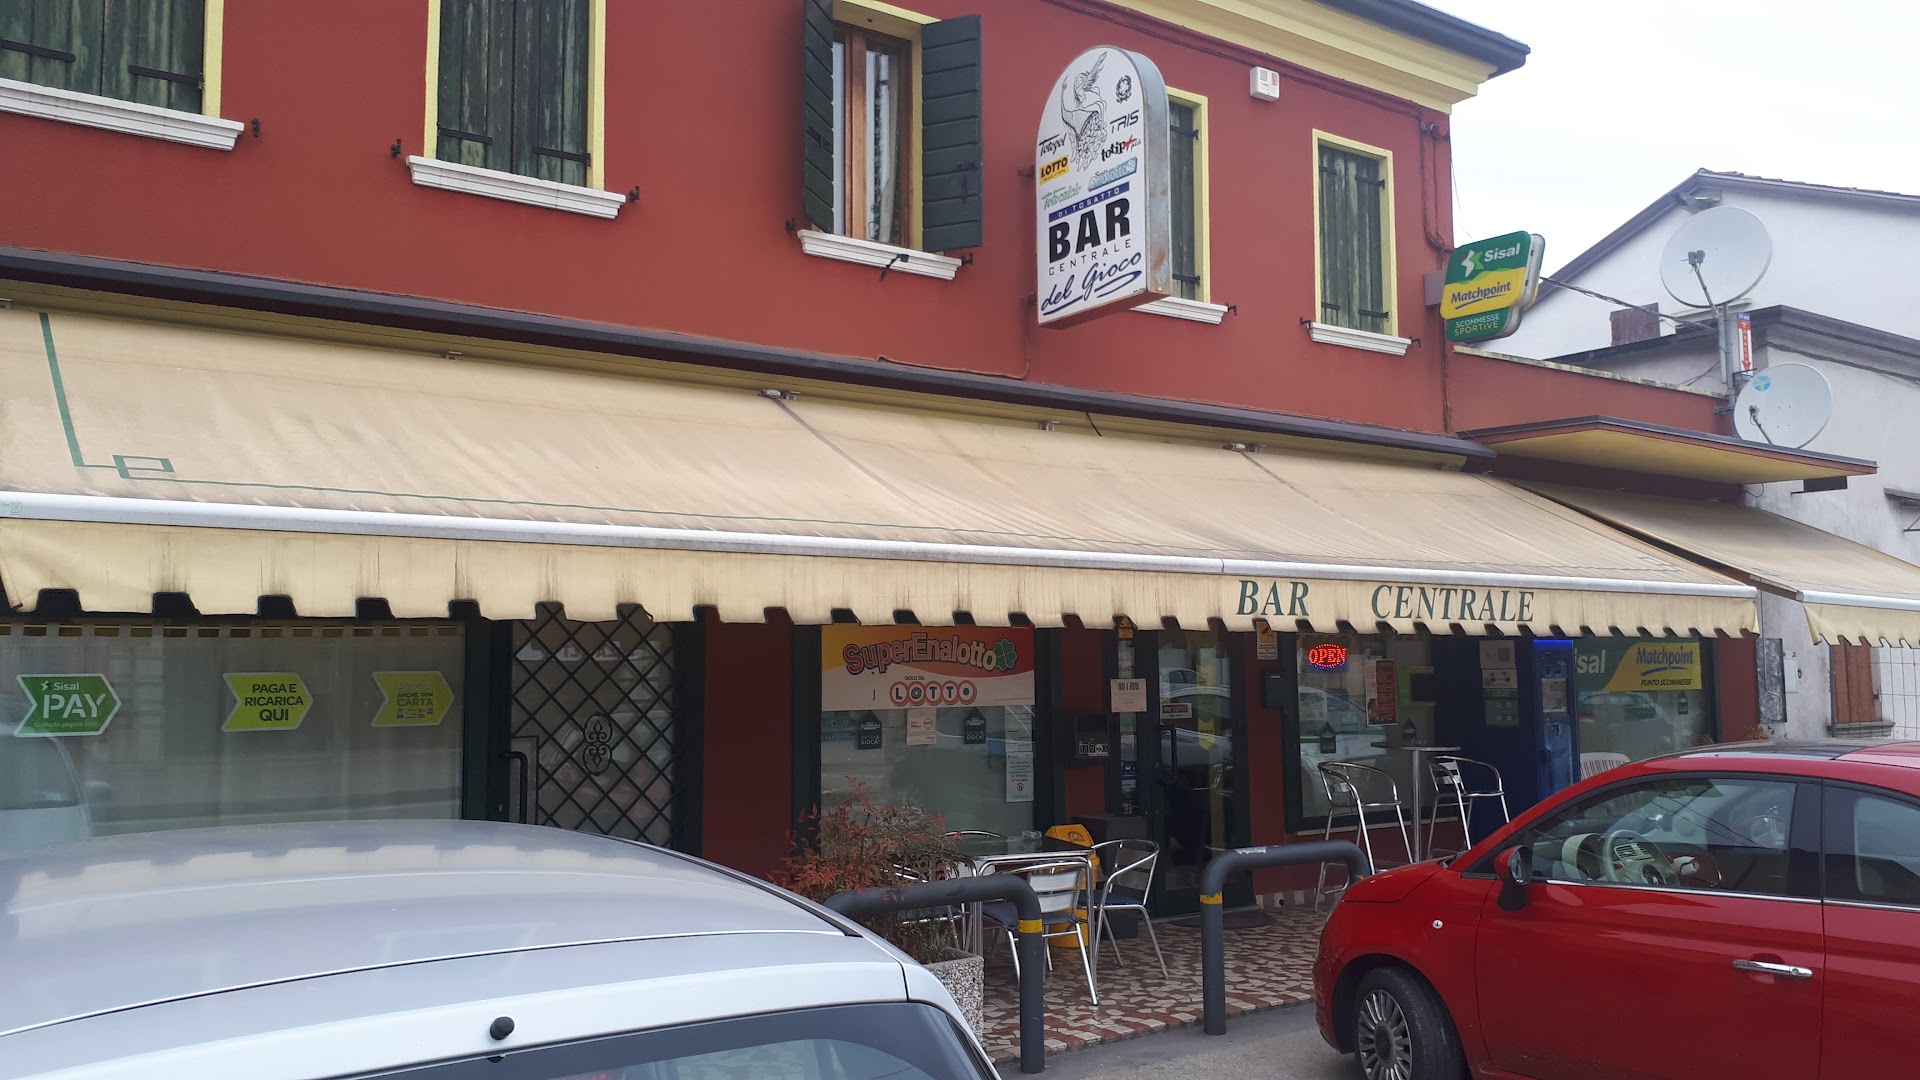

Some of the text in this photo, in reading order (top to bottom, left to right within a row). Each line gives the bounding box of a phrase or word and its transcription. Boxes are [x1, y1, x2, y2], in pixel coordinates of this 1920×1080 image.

[1110, 109, 1140, 134] TRIS
[1040, 156, 1068, 179] LOTTO
[1058, 210, 1068, 218] DI
[1072, 187, 1120, 212] TOSATTO
[1048, 197, 1131, 264] BAR
[1048, 238, 1131, 276] CENTRALE
[1484, 242, 1521, 263] Sisal
[1041, 251, 1142, 313] del Gioco
[1450, 281, 1512, 304] Matchpoint
[1453, 320, 1499, 337] SPORTIVE
[1455, 313, 1501, 329] SCOMMESSE
[1235, 579, 1535, 623] BAR CENTRALE
[842, 631, 997, 676] SuperEnalotto
[1308, 648, 1347, 664] OPEN
[1573, 647, 1606, 674] isal
[1636, 645, 1694, 670] Matchpoint
[53, 681, 80, 691] Sisal
[252, 683, 297, 694] PAGA E
[893, 684, 973, 703] LOTTO
[1640, 678, 1692, 687] PUNTO SCOMMESSE
[43, 693, 107, 719] PAY
[244, 695, 304, 706] RICARICA
[397, 698, 434, 707] CARTA
[259, 708, 289, 721] QUI
